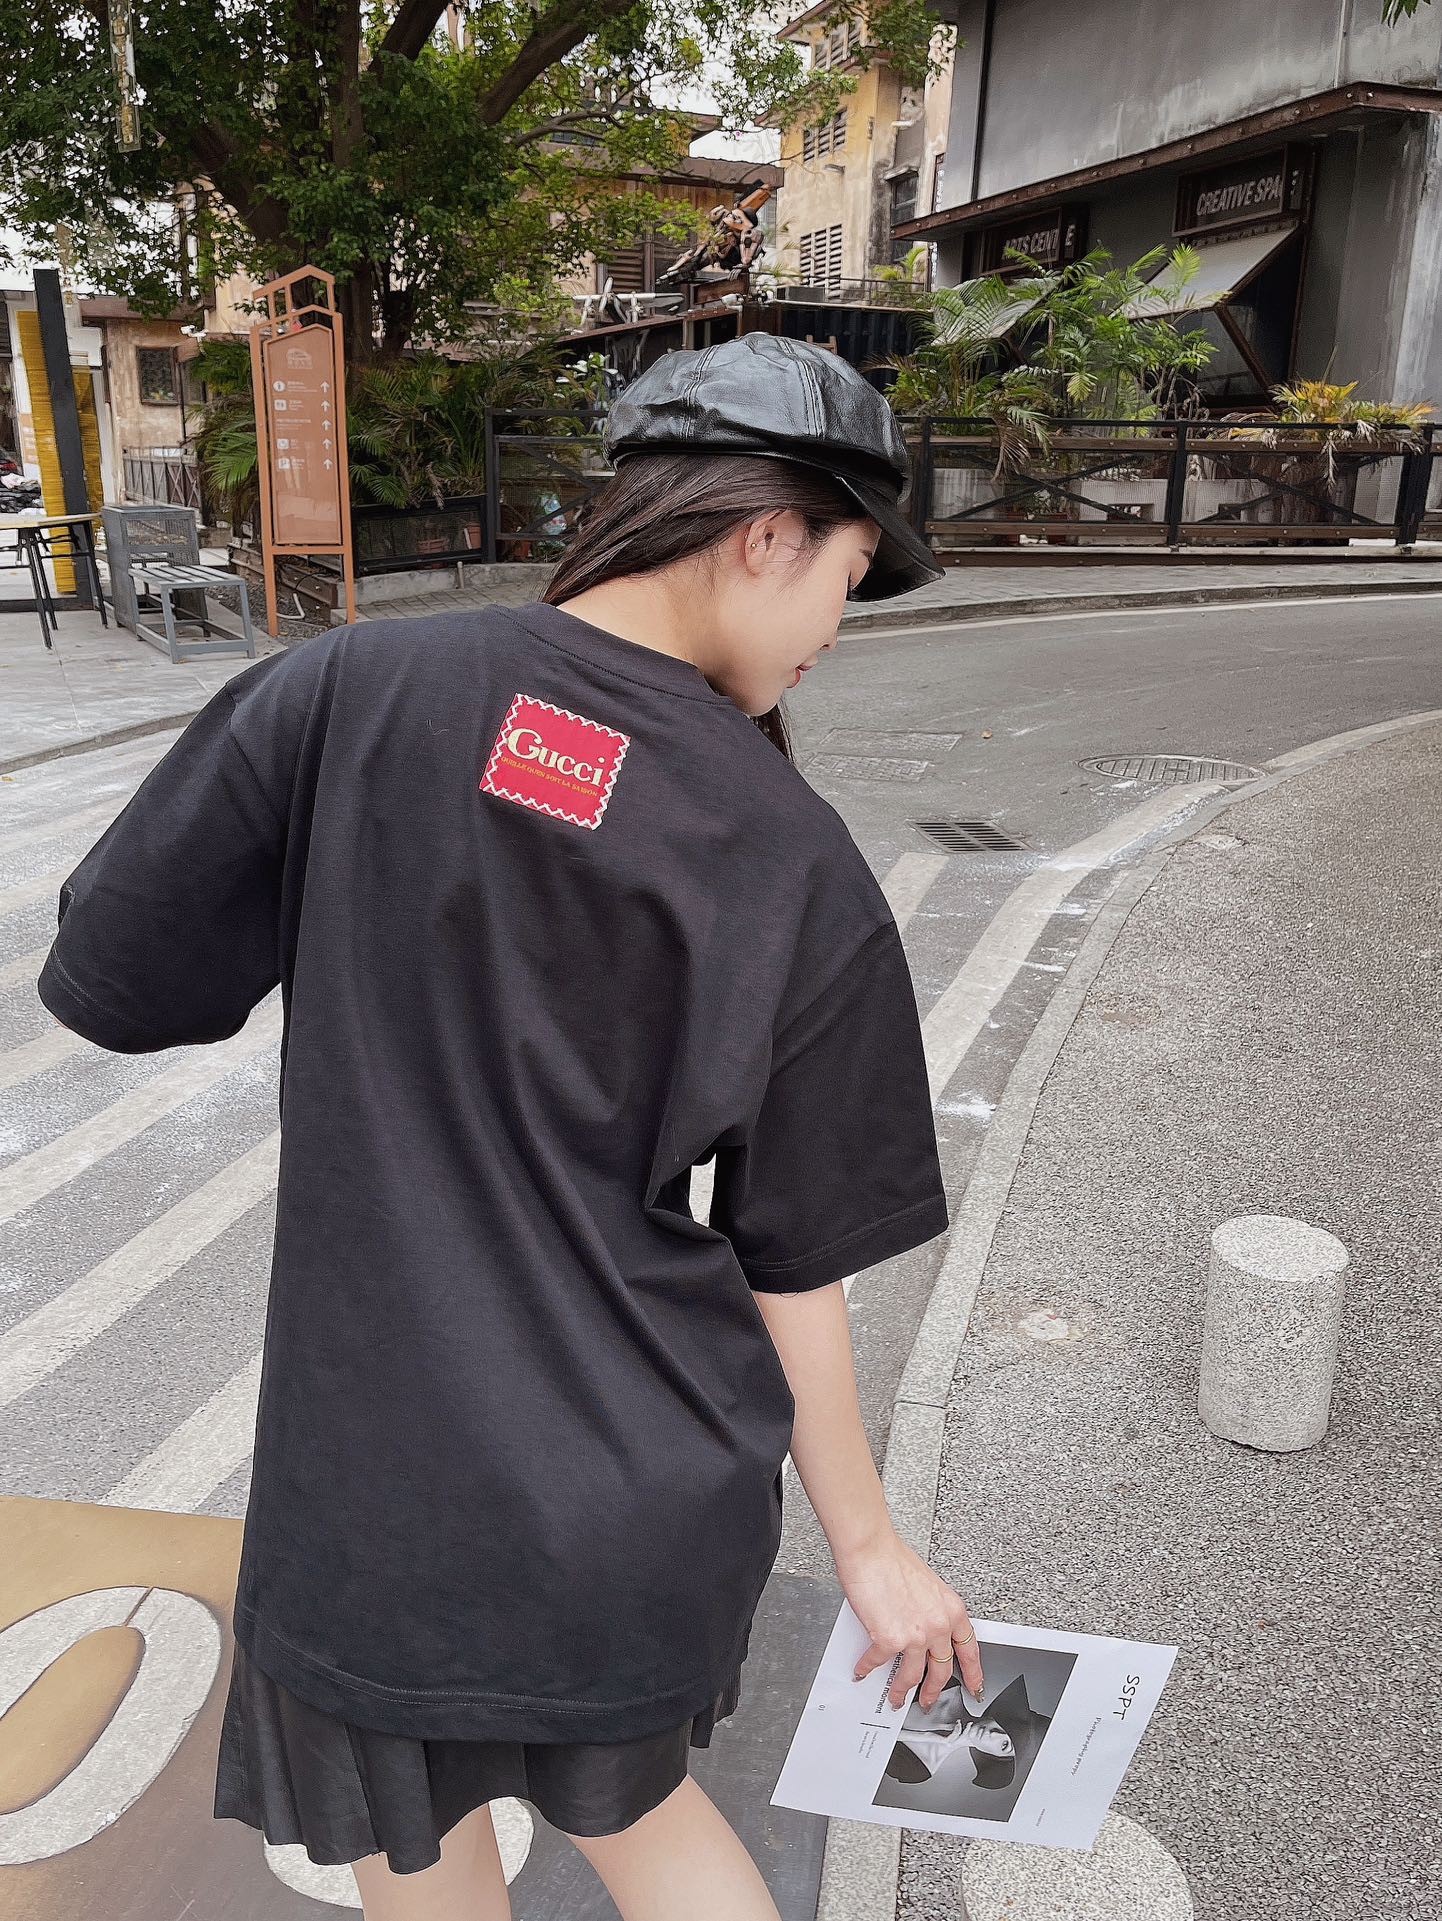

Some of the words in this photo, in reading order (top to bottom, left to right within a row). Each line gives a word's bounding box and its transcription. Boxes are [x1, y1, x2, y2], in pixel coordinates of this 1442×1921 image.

[1196, 180, 1256, 216] CREATIVE
[1030, 224, 1076, 254] CENTE
[507, 727, 605, 787] Gucci
[887, 1651, 905, 1688] Aesthetical
[875, 1686, 890, 1714] moment
[1112, 1674, 1140, 1721] SSPT
